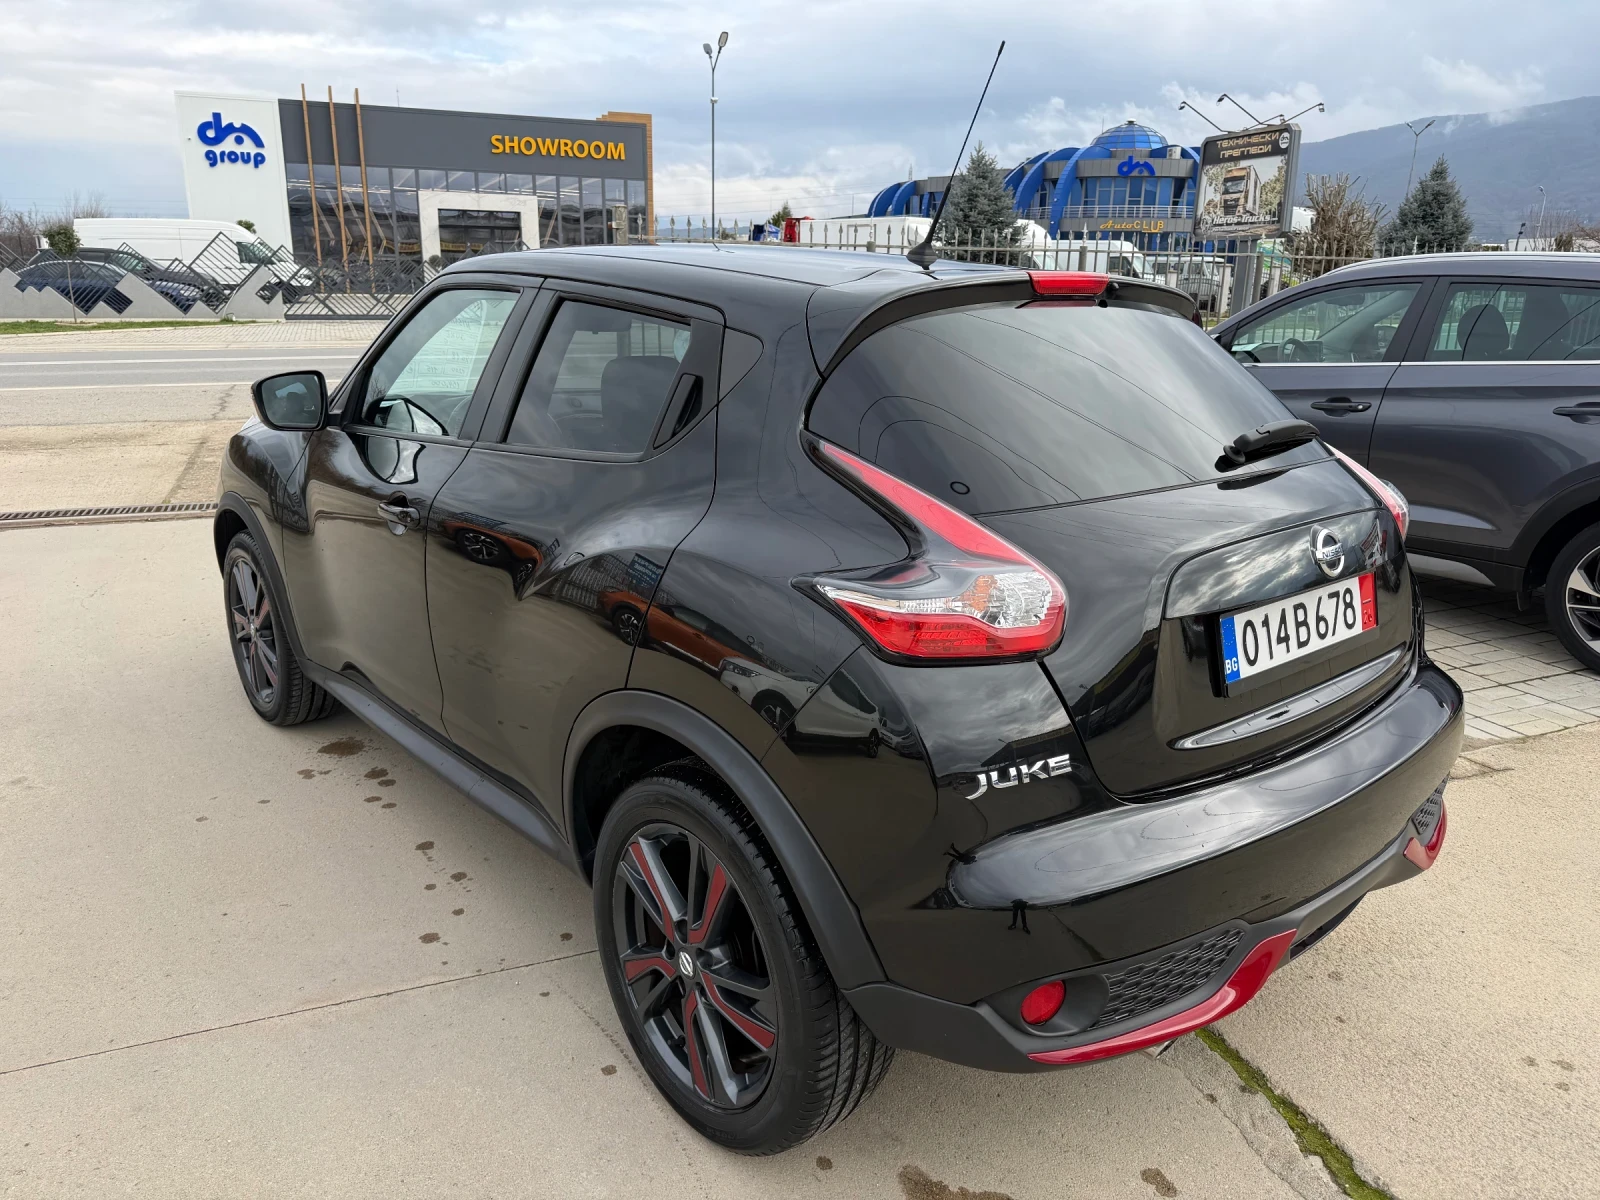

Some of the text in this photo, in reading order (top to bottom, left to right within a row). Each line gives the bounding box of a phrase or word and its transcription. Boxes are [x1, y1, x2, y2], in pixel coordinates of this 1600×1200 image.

[491, 135, 626, 160] SHOWROOM
[1216, 132, 1279, 148] ТЕХНИЧЕСКИ
[205, 149, 266, 169] group
[1242, 588, 1357, 667] 014B678
[1225, 657, 1238, 674] BG
[965, 754, 1073, 800] JUKE
